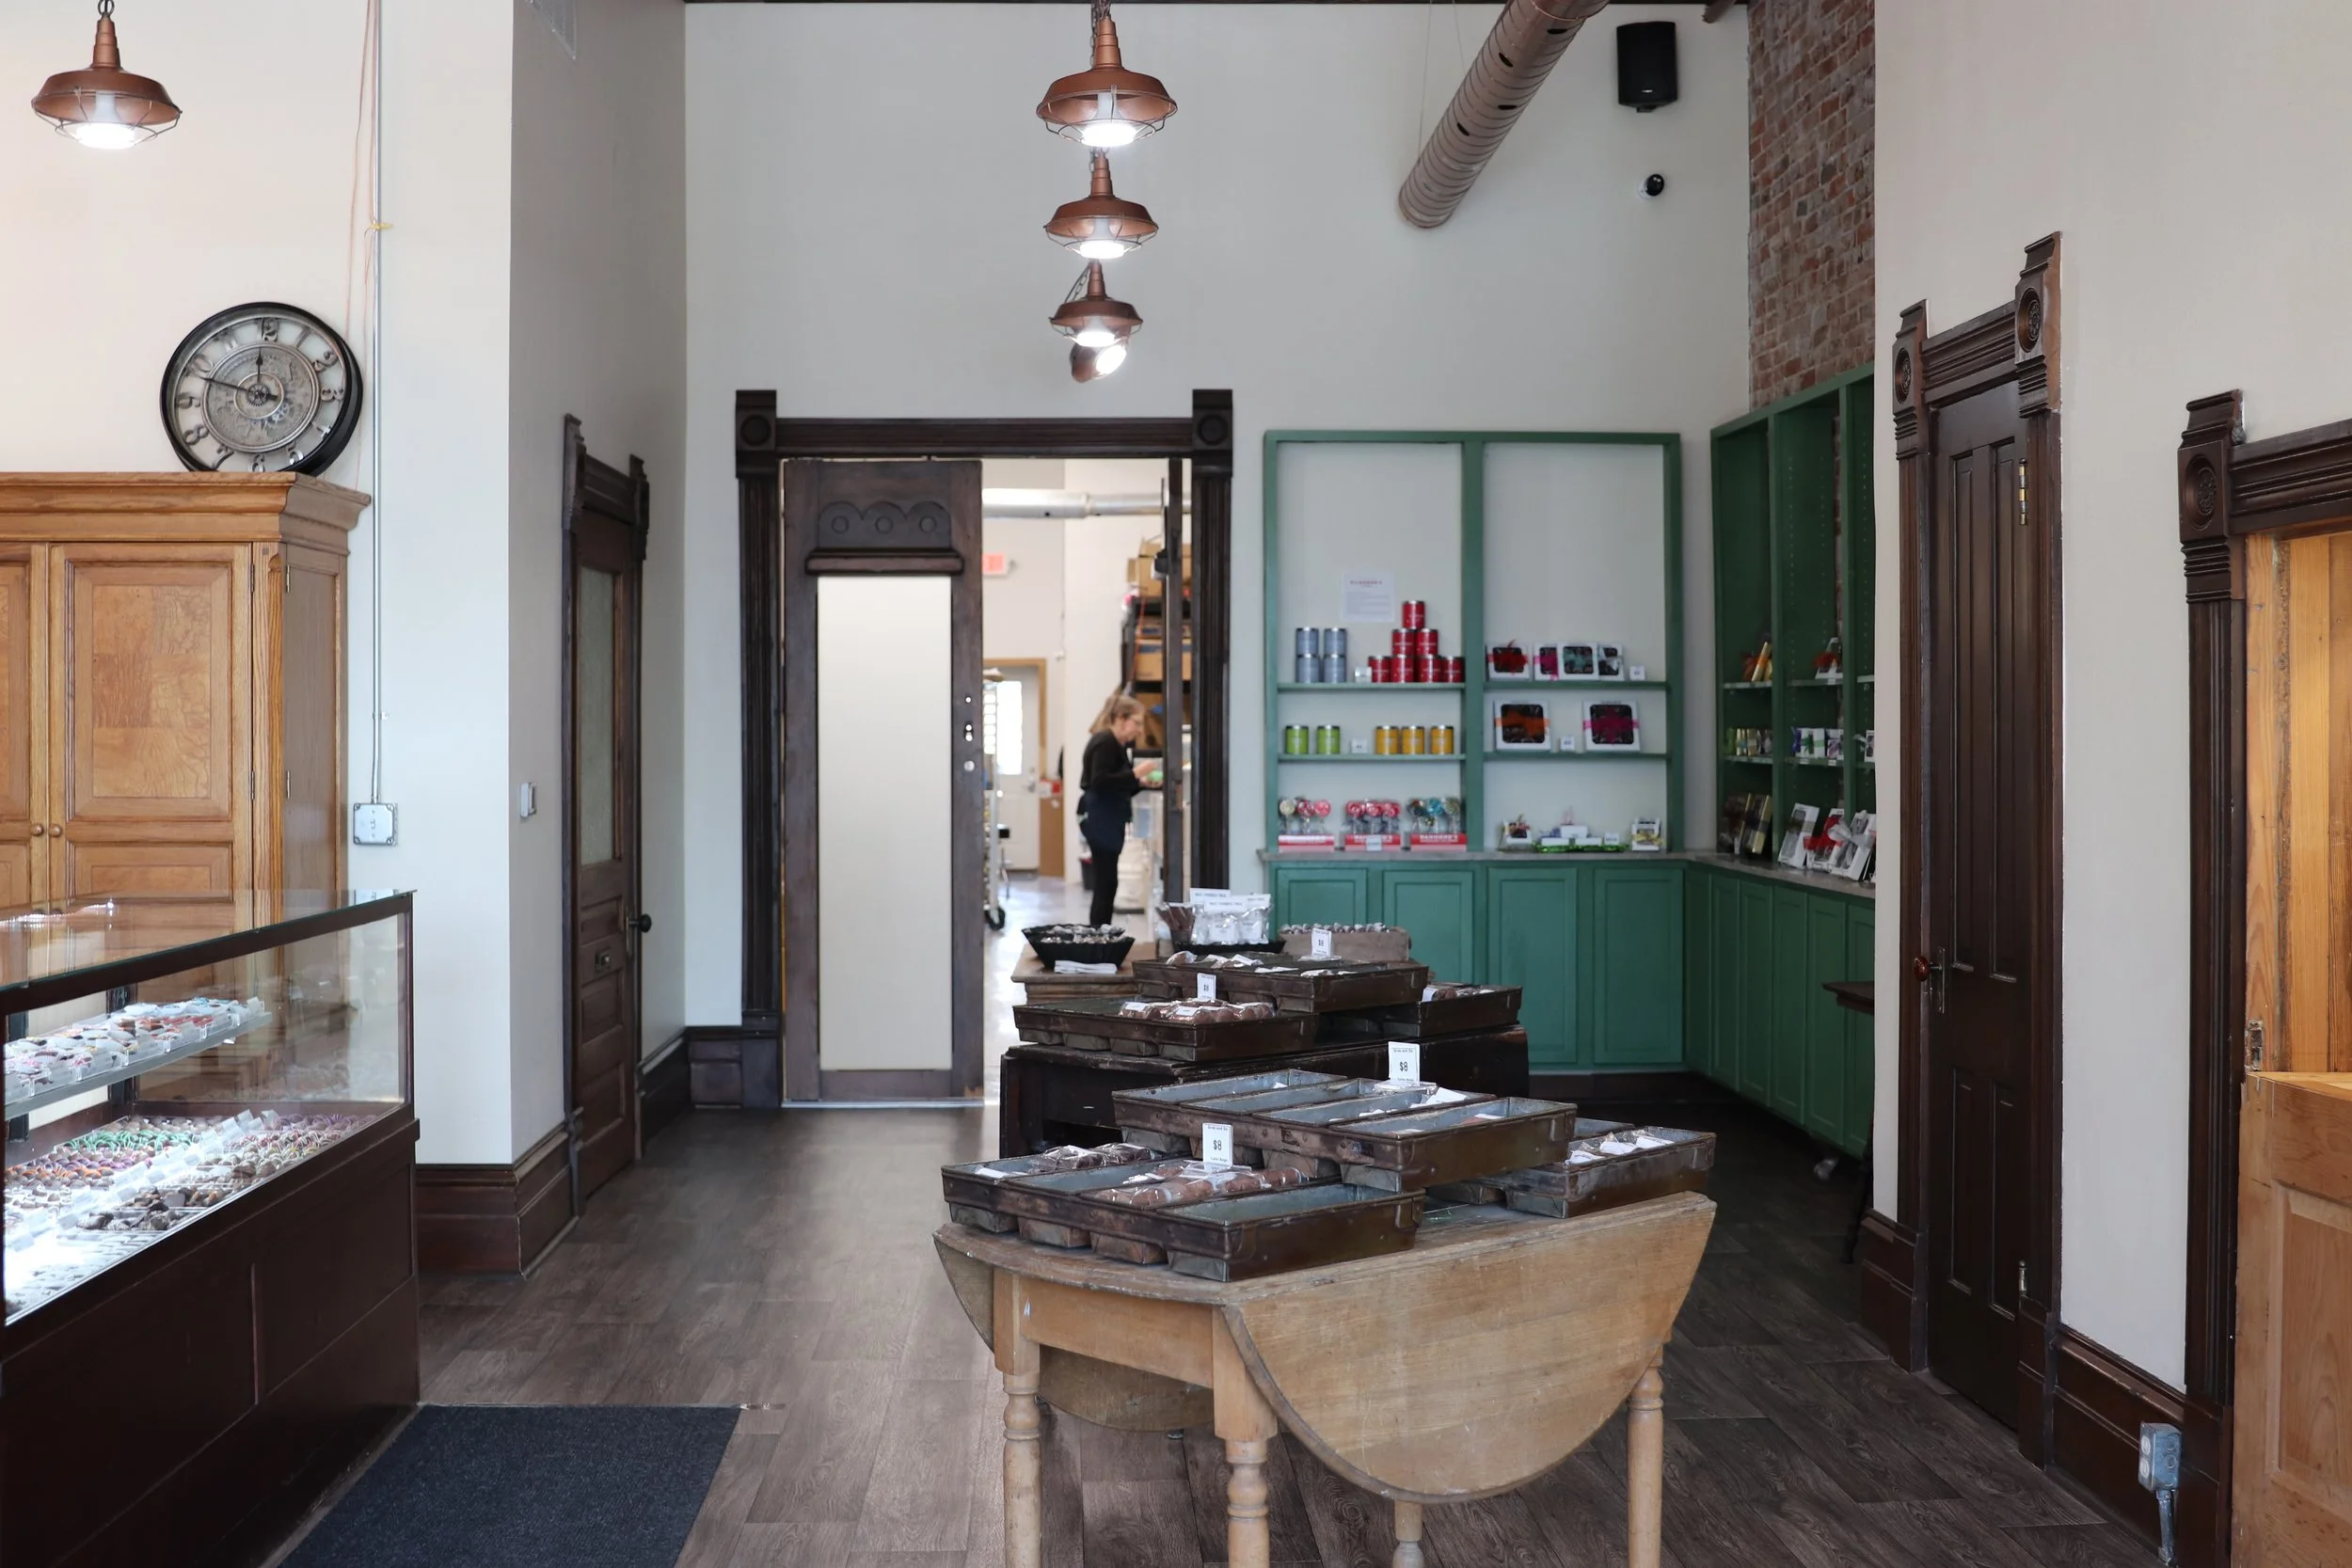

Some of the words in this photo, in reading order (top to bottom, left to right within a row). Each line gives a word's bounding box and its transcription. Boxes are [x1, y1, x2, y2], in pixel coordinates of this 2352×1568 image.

[257, 318, 280, 342] 12
[295, 325, 311, 349] 1
[311, 350, 339, 372] 2
[175, 391, 201, 409] 9
[320, 387, 343, 403] 3
[183, 424, 209, 446] 8
[211, 443, 234, 470] 7
[1400, 1061, 1407, 1072] $8
[1214, 1140, 1222, 1150] $8
